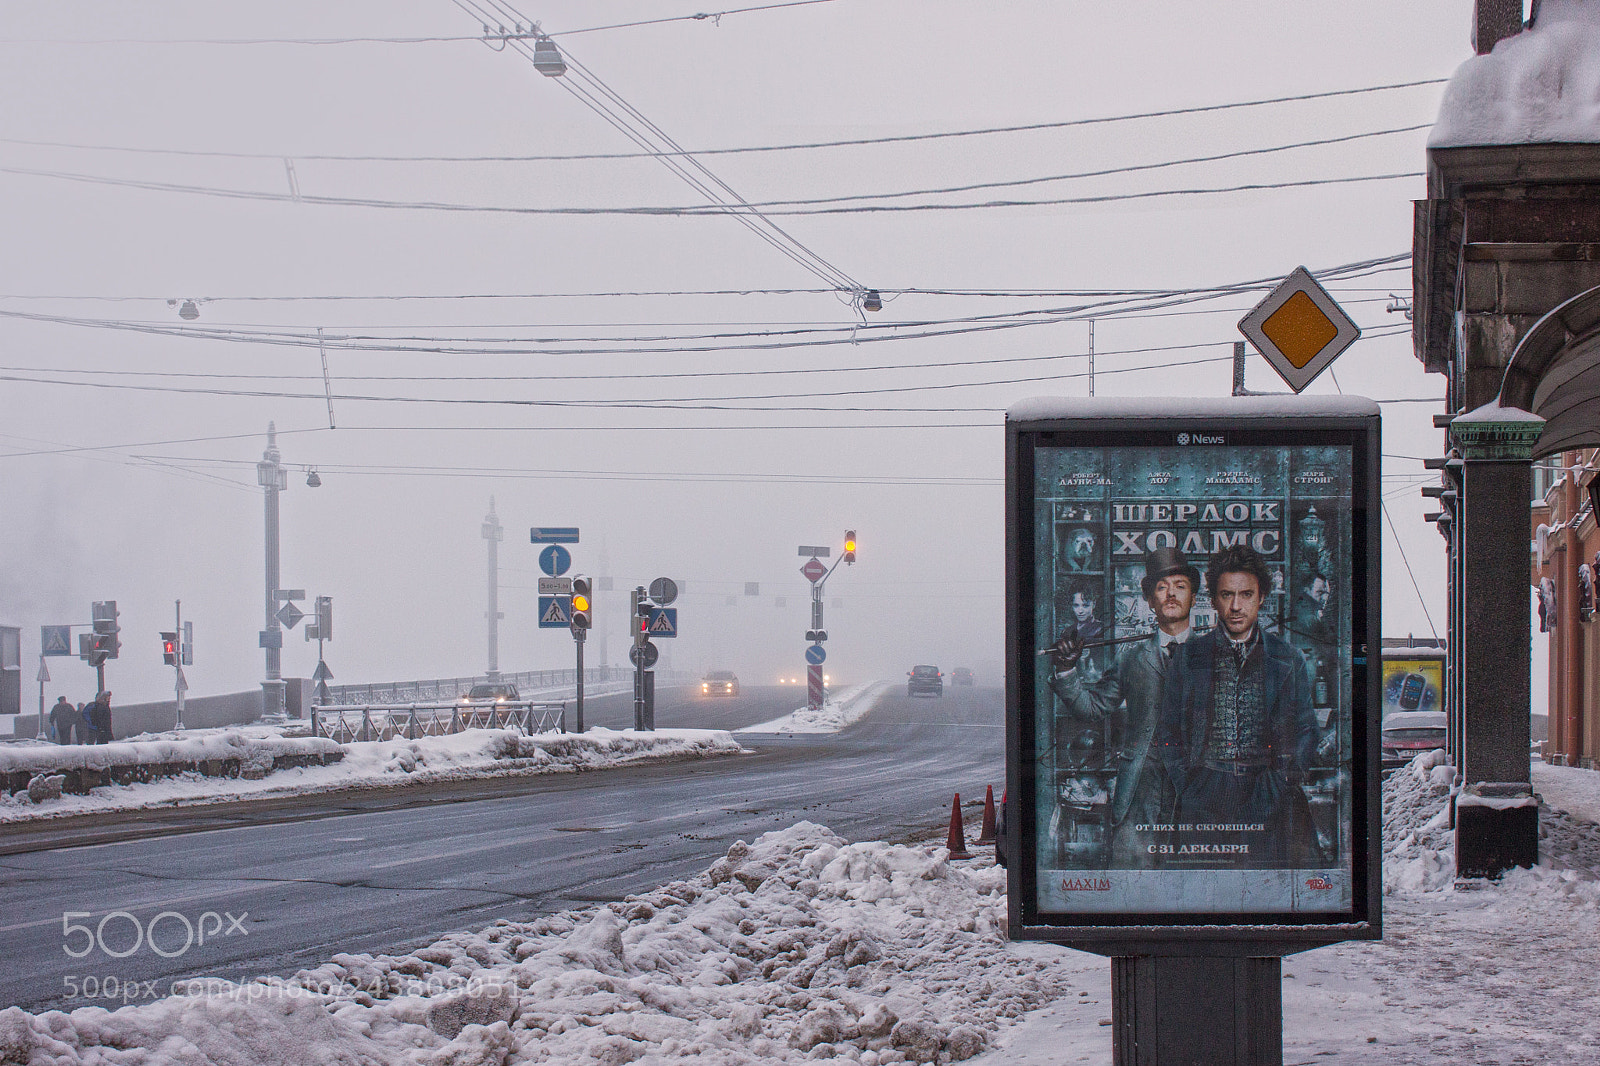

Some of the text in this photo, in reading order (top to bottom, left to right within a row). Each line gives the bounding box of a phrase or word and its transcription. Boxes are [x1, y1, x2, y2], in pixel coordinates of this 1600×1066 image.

[1192, 433, 1225, 444] News
[1294, 476, 1334, 484] СТРОНГ
[1113, 503, 1279, 523] ШЕРЛОК
[1112, 530, 1280, 555] ХОЛМС
[1196, 823, 1265, 831] СКРОЕШЬСЯ
[1147, 844, 1249, 855] С 31 ДЕКАБРЯ
[1061, 878, 1111, 889] MAXIM
